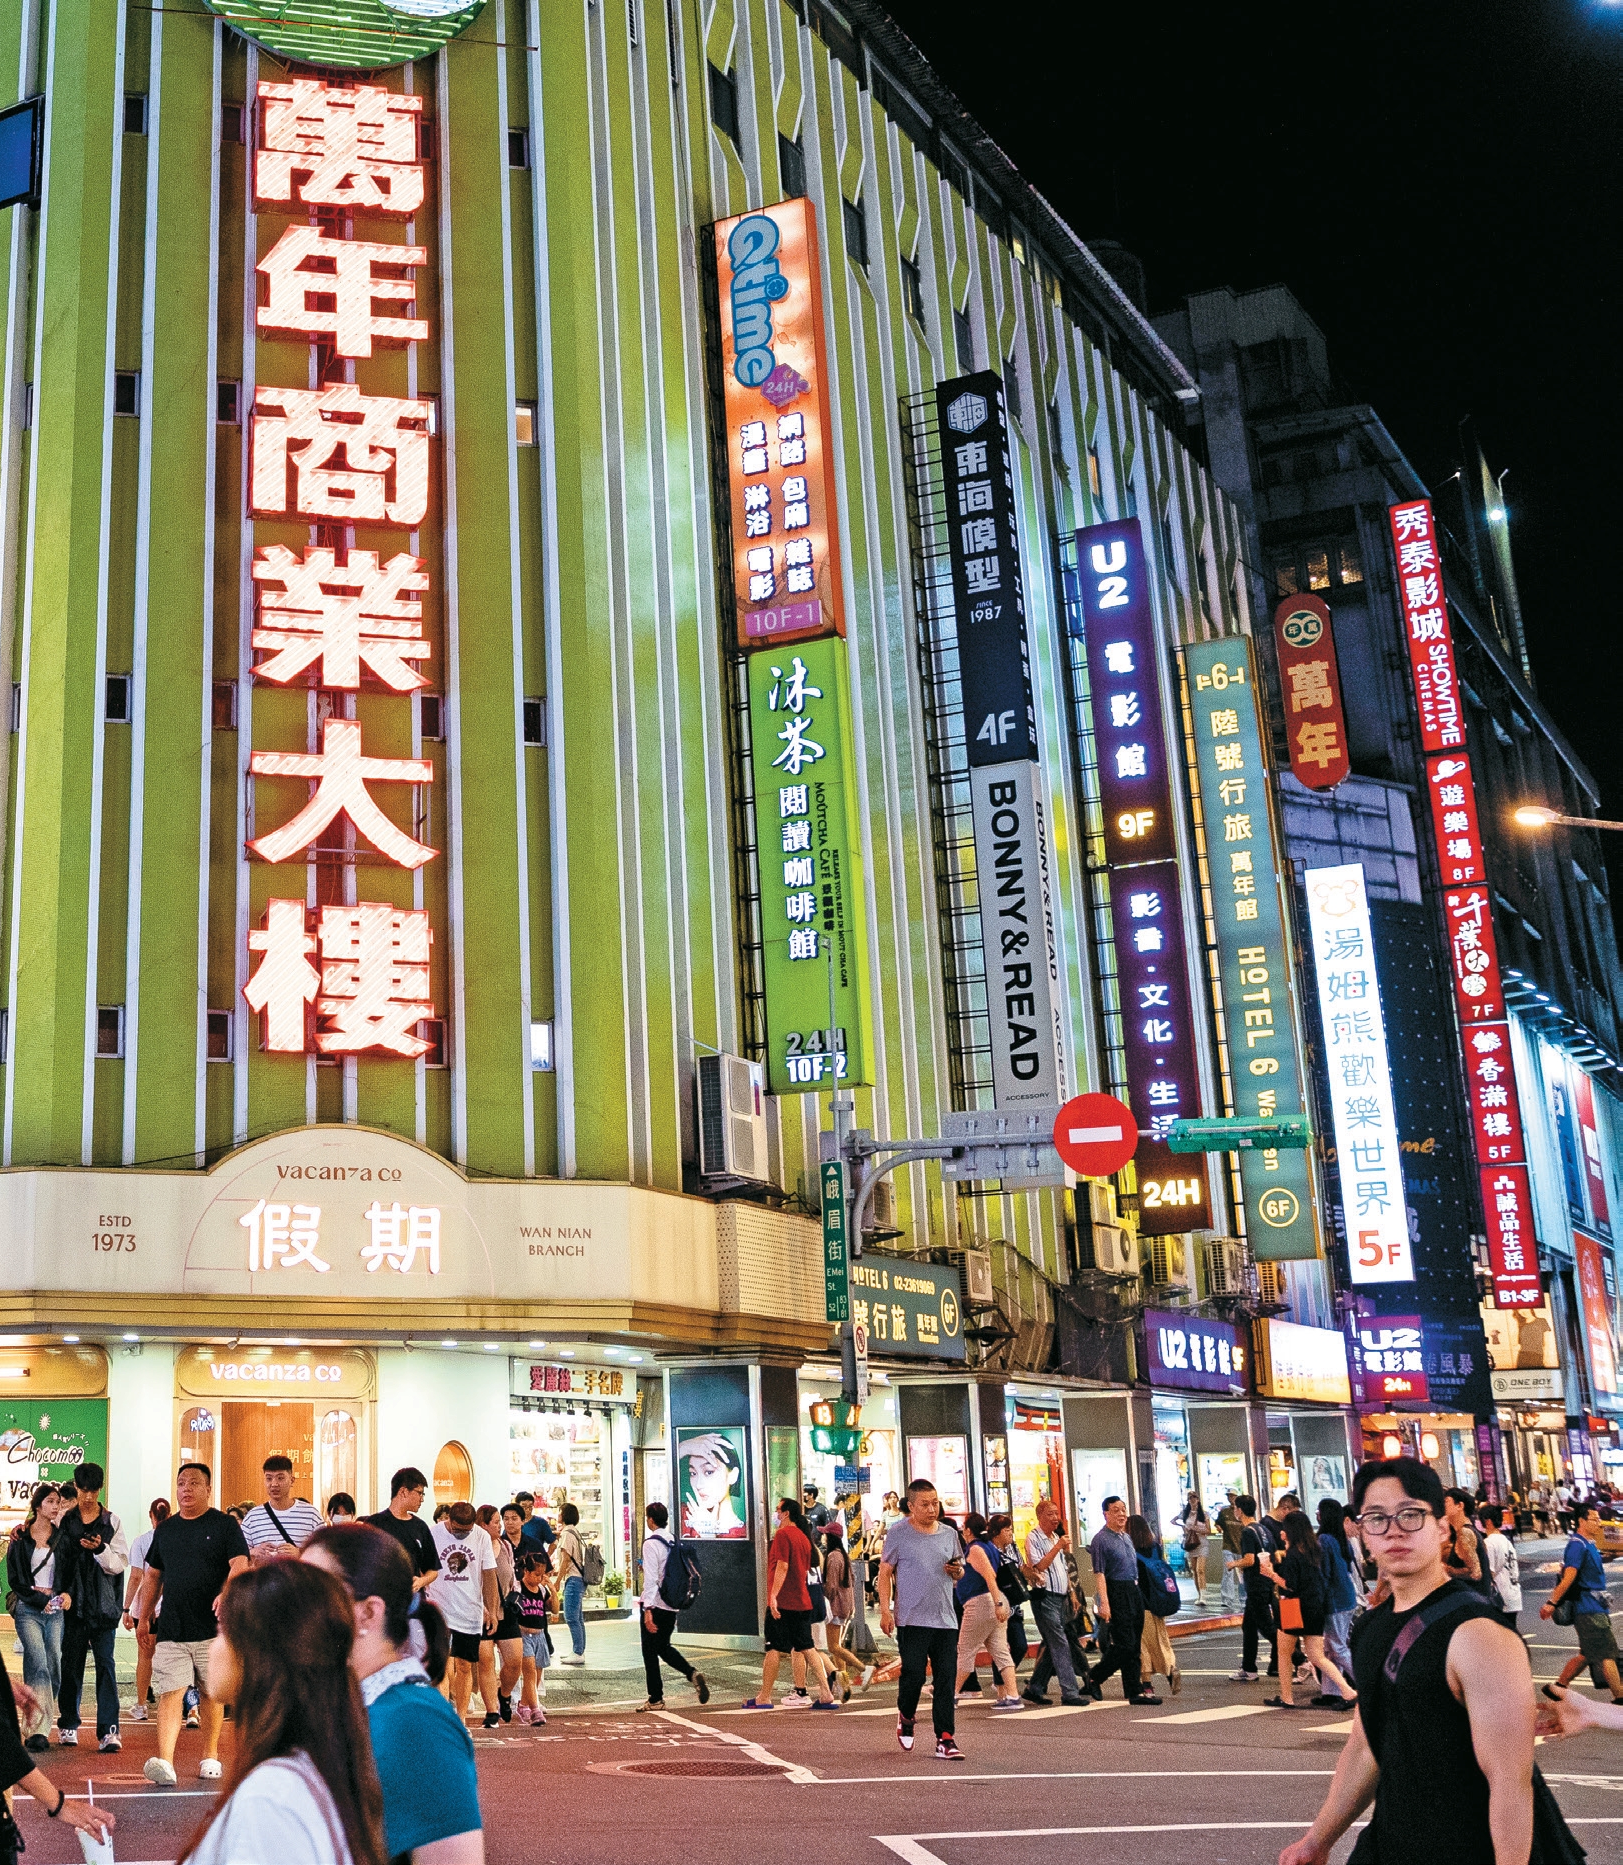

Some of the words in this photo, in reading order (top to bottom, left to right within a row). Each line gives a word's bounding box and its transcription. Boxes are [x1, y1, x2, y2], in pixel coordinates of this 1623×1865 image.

[766, 379, 795, 397] 24H
[744, 483, 772, 538] 淋浴
[954, 440, 1002, 595] 東海模型
[243, 79, 439, 1058] 萬年商業大樓
[746, 545, 775, 601] 電影
[1091, 540, 1129, 610] U2
[1394, 504, 1445, 643] 秀泰影城
[752, 604, 817, 631] 10F-1
[970, 606, 1002, 624] 1987
[1416, 663, 1438, 733] CINEMAS
[1428, 643, 1461, 746] SHOWTIME
[1104, 641, 1148, 779] 電影館
[1286, 660, 1342, 769] 萬年
[977, 709, 1017, 746] 4F
[1209, 708, 1254, 843] 陸號行旅
[1117, 810, 1155, 839] 9F
[1439, 785, 1472, 860] 遊樂場
[779, 783, 819, 961] 閱讀咖啡館
[820, 849, 833, 879] CAFÉ
[1452, 866, 1475, 881] 8F
[1229, 849, 1258, 922] 萬年館
[988, 779, 1040, 1082] BONNY&READ
[1236, 945, 1275, 1048] HOTEL
[1472, 1004, 1494, 1018] 7F
[786, 1027, 846, 1056] 24H
[786, 1055, 848, 1082] 10F-2
[1249, 1057, 1279, 1076] 6
[1322, 928, 1391, 1216] 湯姆熊歡樂世界
[1005, 1092, 1050, 1102] ACCESSORY
[1488, 1145, 1511, 1159] 5F
[277, 1165, 372, 1182] vacanza
[1142, 1178, 1201, 1207] 24H
[98, 1215, 132, 1228] ESTD
[826, 1180, 842, 1261] 峨眉街
[1266, 1199, 1290, 1218] 6F
[91, 1233, 137, 1254] 1973
[239, 1199, 441, 1274] 假期
[520, 1226, 552, 1240] WAN
[557, 1227, 592, 1240] NIAN
[1496, 1192, 1524, 1271] 誠品生活
[528, 1244, 585, 1258] BRANCH
[1358, 1230, 1401, 1267] 5F
[853, 1266, 881, 1289] HOTEL
[882, 1270, 888, 1290] 6
[1498, 1289, 1539, 1303] B1-3F
[834, 1299, 907, 1341] 號行旅
[944, 1303, 954, 1324] 6F
[1159, 1327, 1188, 1368] U2
[1361, 1328, 1421, 1350] U2
[210, 1364, 311, 1381] vacanza
[314, 1364, 342, 1382] co
[1384, 1377, 1412, 1392] 24H
[1532, 1378, 1551, 1386] BOY
